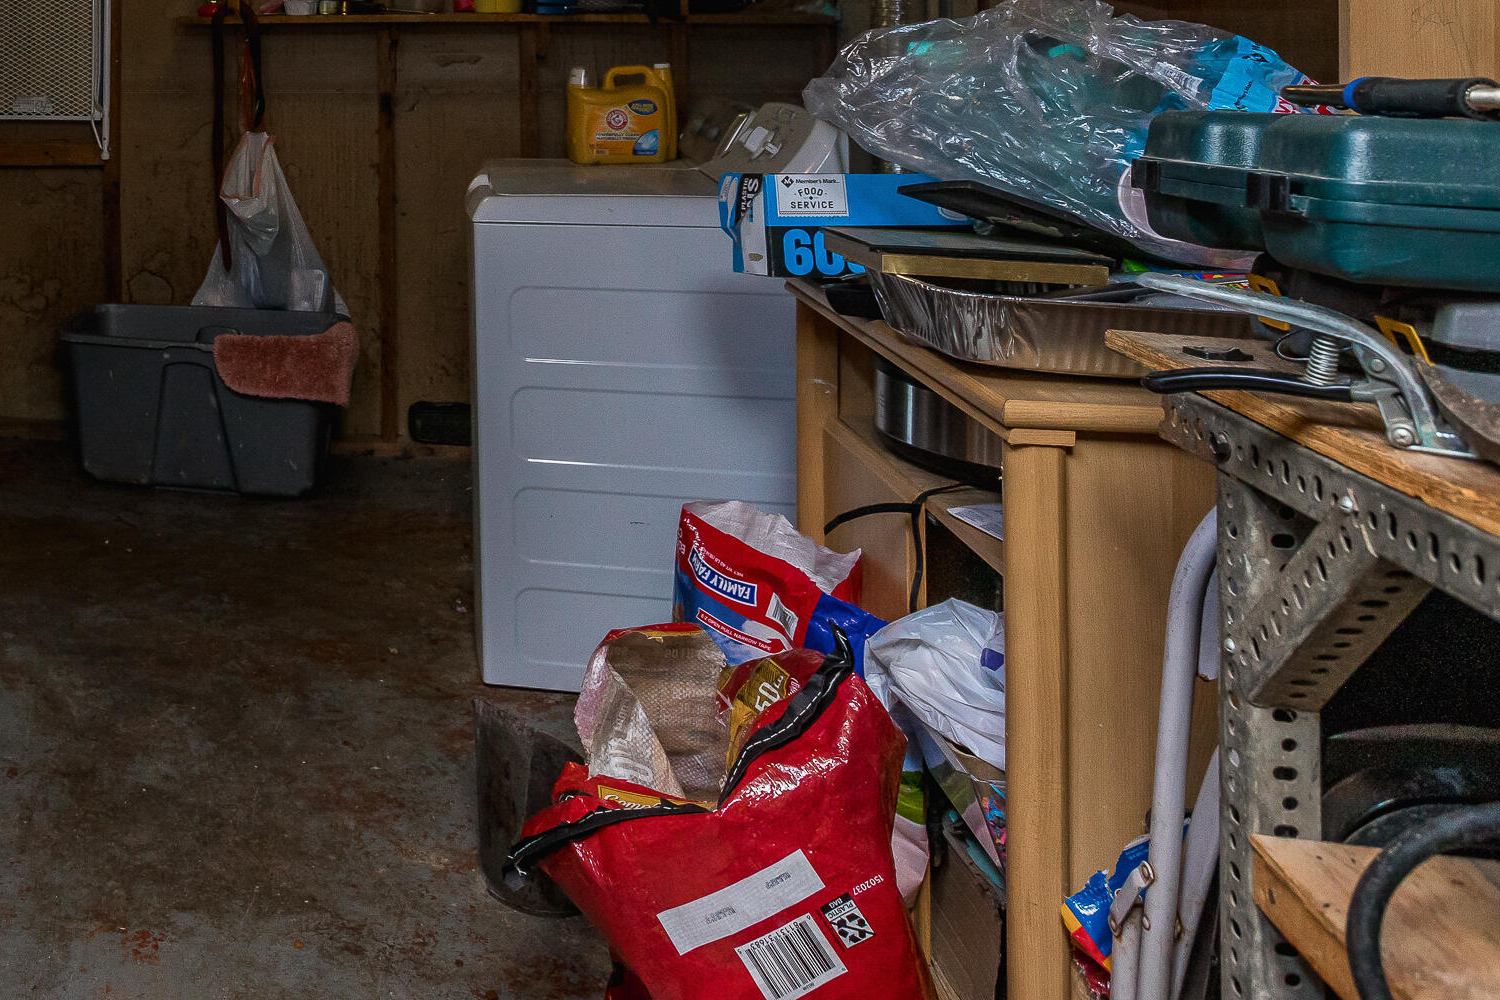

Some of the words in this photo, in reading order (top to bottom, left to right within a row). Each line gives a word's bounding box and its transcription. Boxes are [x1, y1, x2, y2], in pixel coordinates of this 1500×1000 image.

[741, 177, 749, 210] PLASTIC
[798, 187, 824, 197] FOOD
[790, 201, 834, 209] SERVICE
[783, 228, 866, 276] 60
[709, 573, 751, 600] FAMILY
[720, 624, 732, 636] PULL
[734, 632, 757, 646] NARROW
[757, 641, 772, 652] TAPE
[827, 901, 854, 919] PLASTIC
[829, 897, 843, 909] BAG
